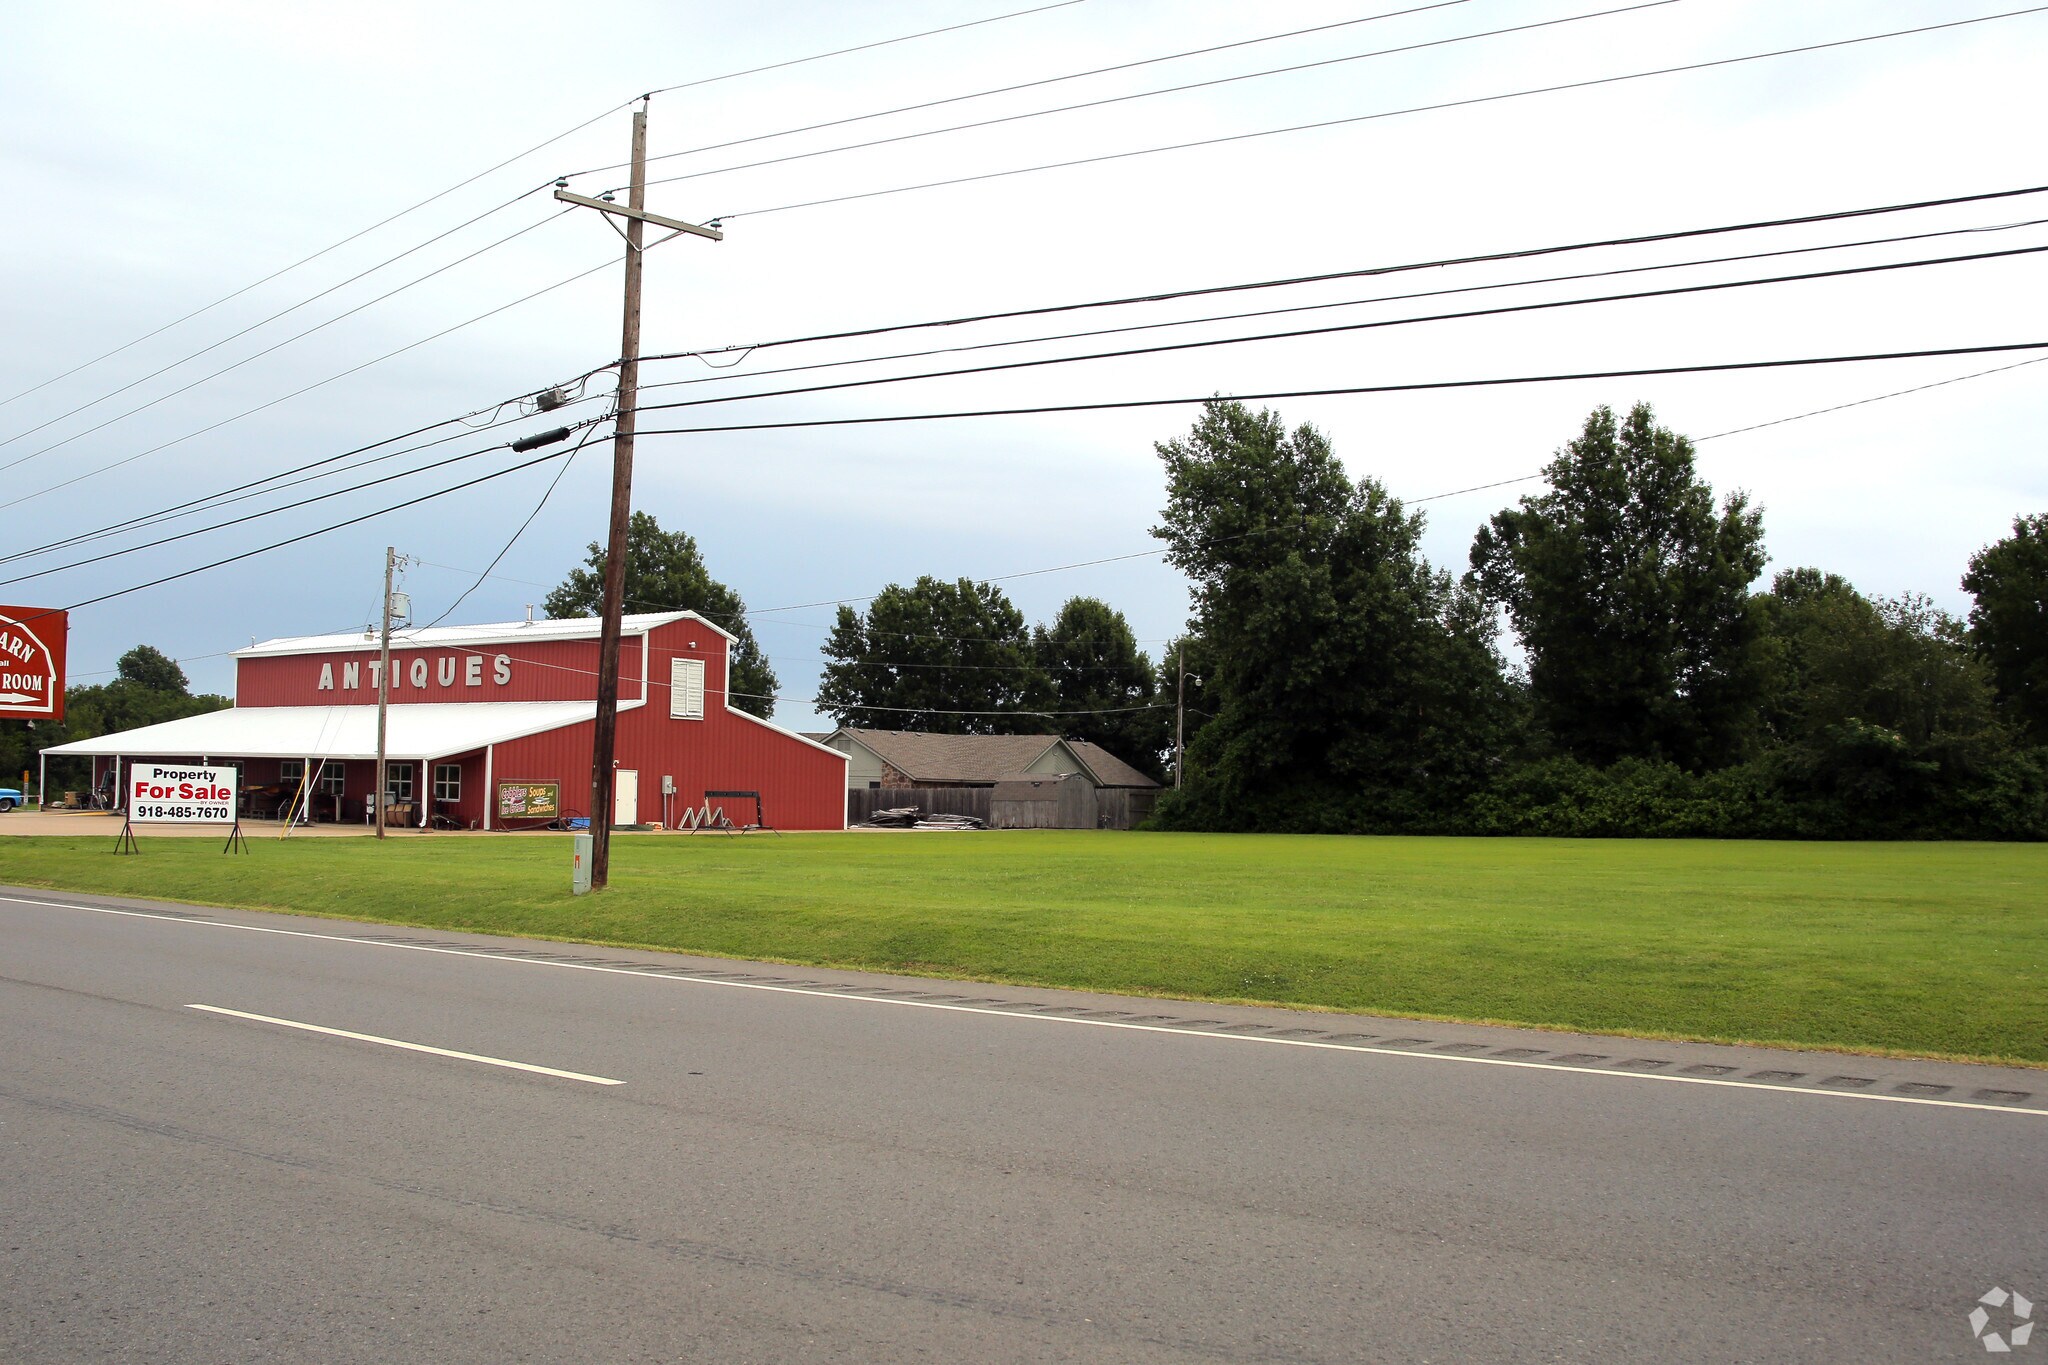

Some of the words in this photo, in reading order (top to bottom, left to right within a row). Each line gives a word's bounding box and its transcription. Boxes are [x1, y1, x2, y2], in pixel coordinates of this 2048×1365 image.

[318, 653, 511, 690] ANTIQUES
[2, 673, 42, 691] ROOM
[153, 768, 216, 782] Property
[135, 782, 175, 799] For
[178, 783, 231, 800] Sale
[502, 786, 527, 800] Cobblers
[529, 787, 546, 797] Soups
[528, 804, 555, 814] Sandwiches
